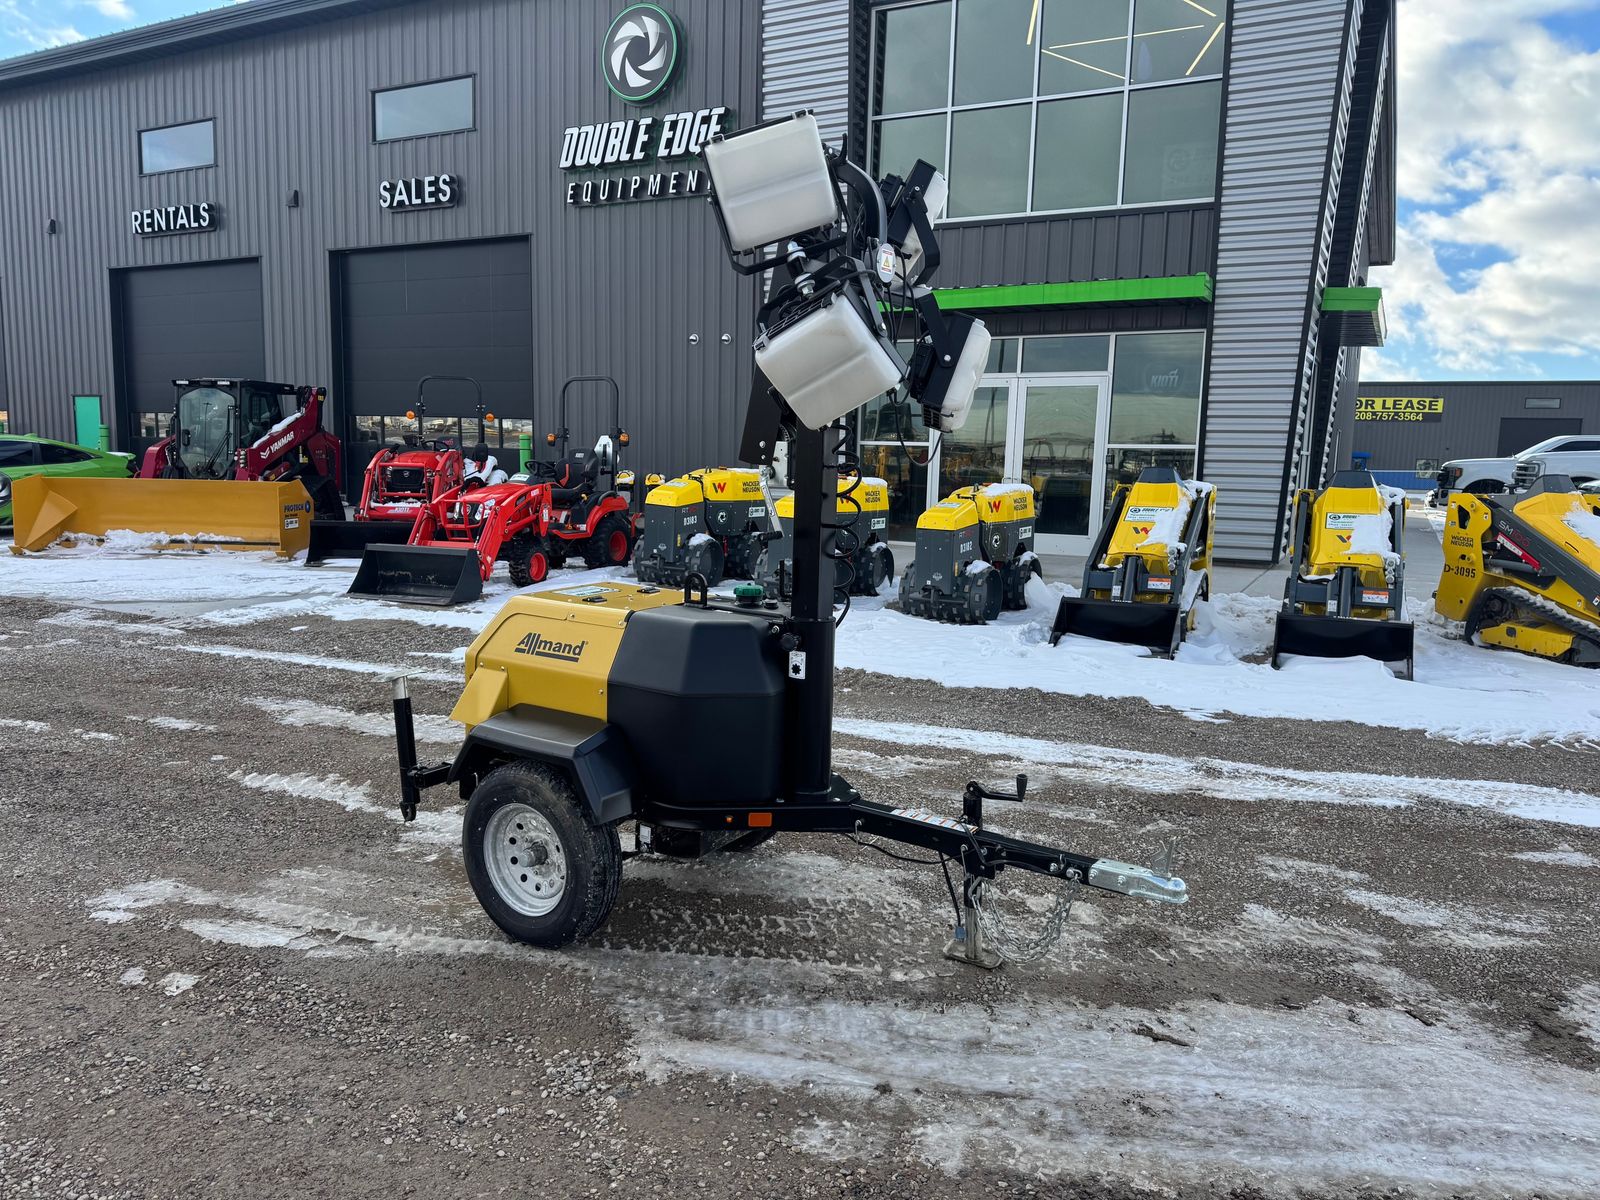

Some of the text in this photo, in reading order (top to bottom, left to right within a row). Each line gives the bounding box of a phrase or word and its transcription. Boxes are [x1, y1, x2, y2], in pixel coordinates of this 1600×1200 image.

[559, 107, 726, 168] DOUBLE EDGE
[380, 174, 451, 208] SALES
[566, 169, 711, 203] EQUIPMEN
[131, 202, 210, 234] RENTALS
[1355, 399, 1439, 411] OR LEASE
[1355, 411, 1424, 421] 208-757-3564
[270, 431, 295, 454] YANMAR
[1451, 535, 1474, 543] WACKER
[1451, 540, 1474, 548] NEUSON
[1444, 564, 1476, 578] D-3095
